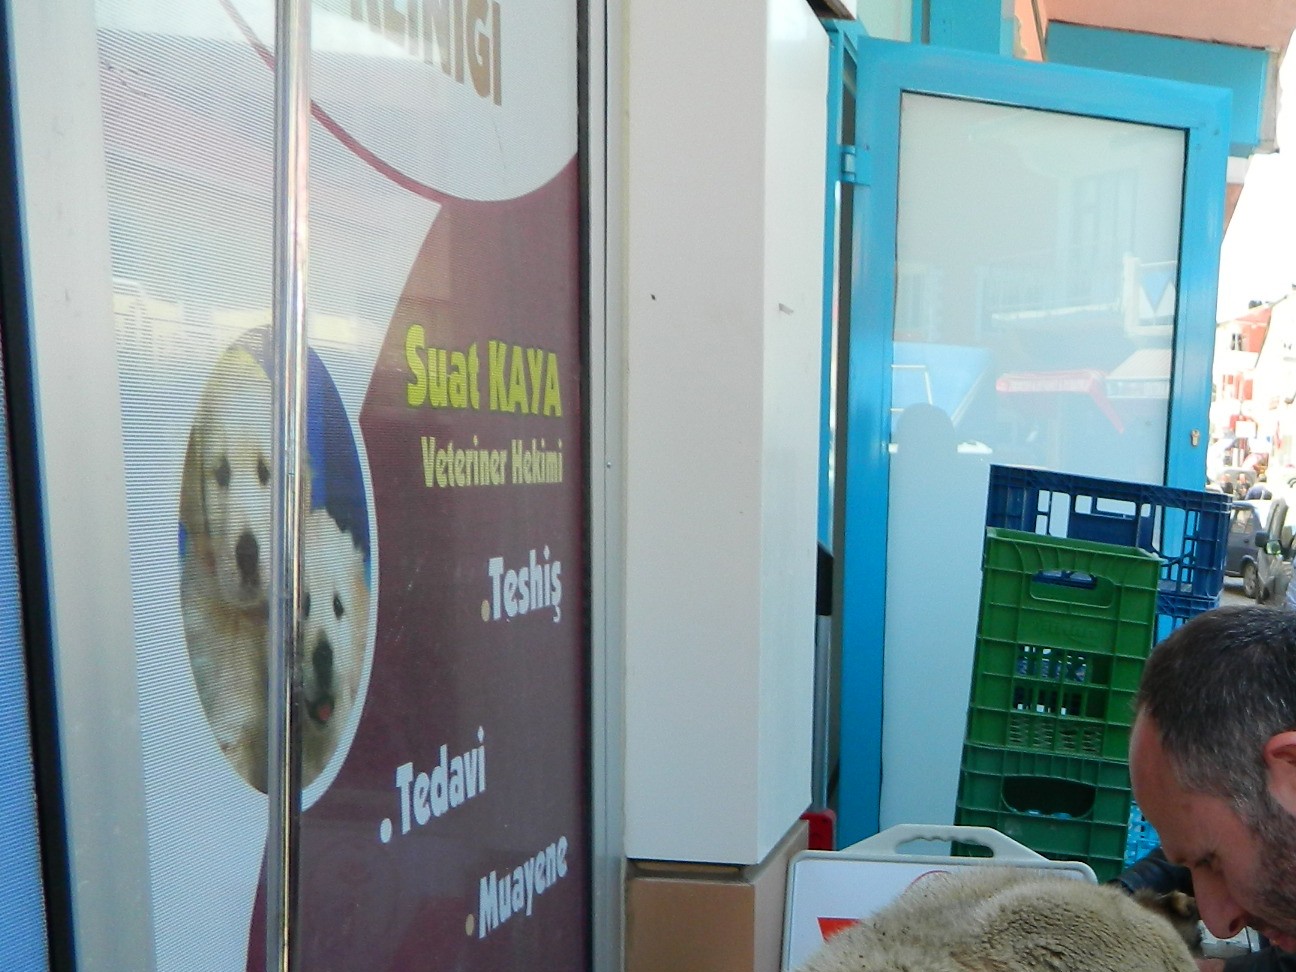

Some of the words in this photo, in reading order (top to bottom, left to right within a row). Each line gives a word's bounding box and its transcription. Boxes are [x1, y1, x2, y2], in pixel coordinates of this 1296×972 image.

[405, 323, 480, 410] Suat
[488, 338, 563, 418] KAYA
[420, 434, 507, 488] Veteriner
[511, 437, 563, 485] Hekimi
[396, 725, 486, 835] Tedavi
[478, 835, 569, 940] Muayene
